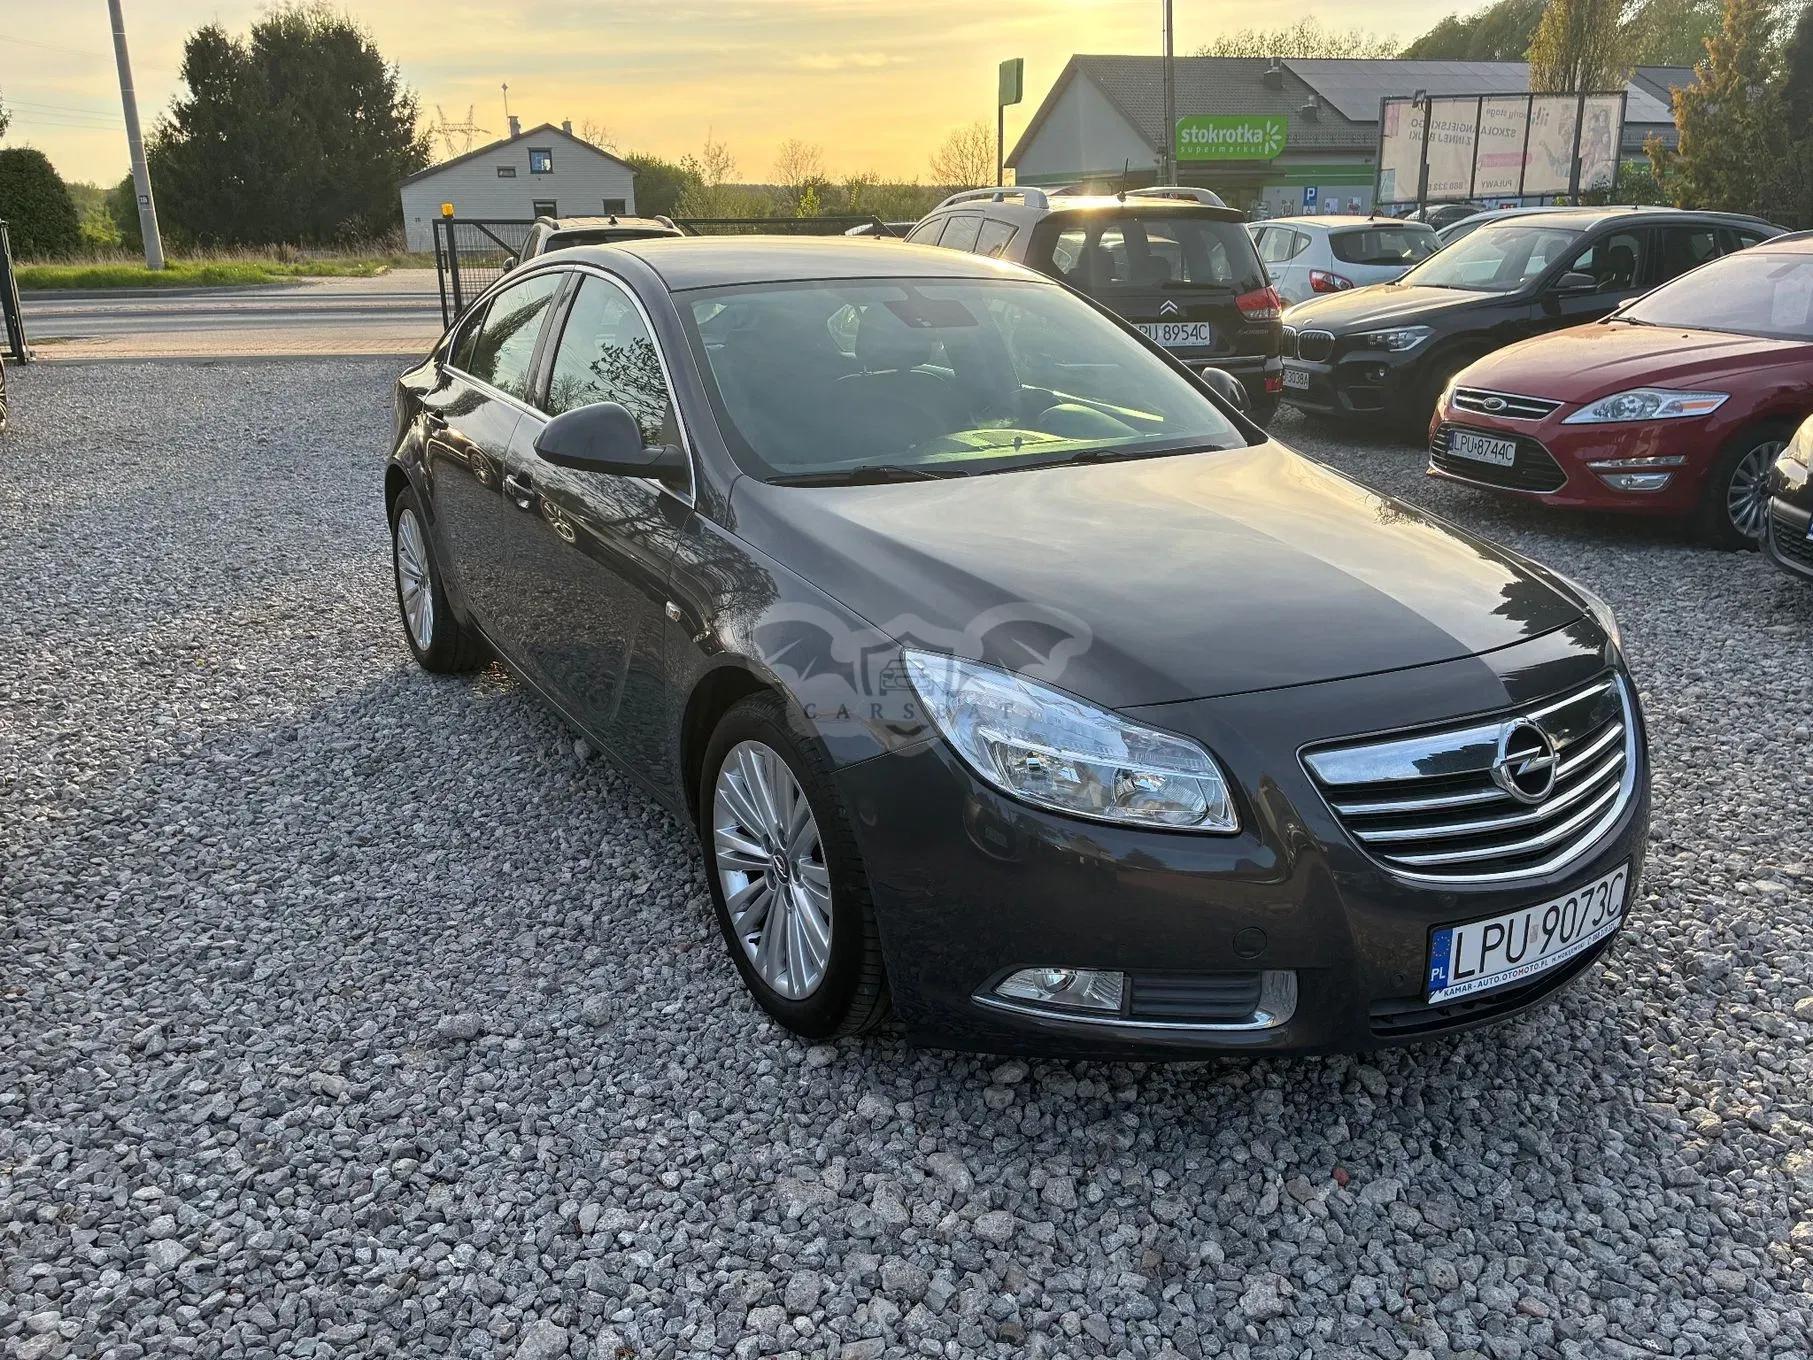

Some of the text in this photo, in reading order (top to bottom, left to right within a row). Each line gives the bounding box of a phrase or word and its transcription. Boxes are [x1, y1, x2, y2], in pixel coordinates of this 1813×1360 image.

[1181, 124, 1263, 144] stokrotka
[1180, 146, 1263, 155] supermarket
[1306, 188, 1316, 201] P
[1138, 324, 1208, 341] PU 8954C
[1454, 432, 1475, 453] LPU
[1476, 439, 1514, 461] 8744C
[1453, 872, 1623, 980] LPU 9073C
[1430, 966, 1446, 982] PL
